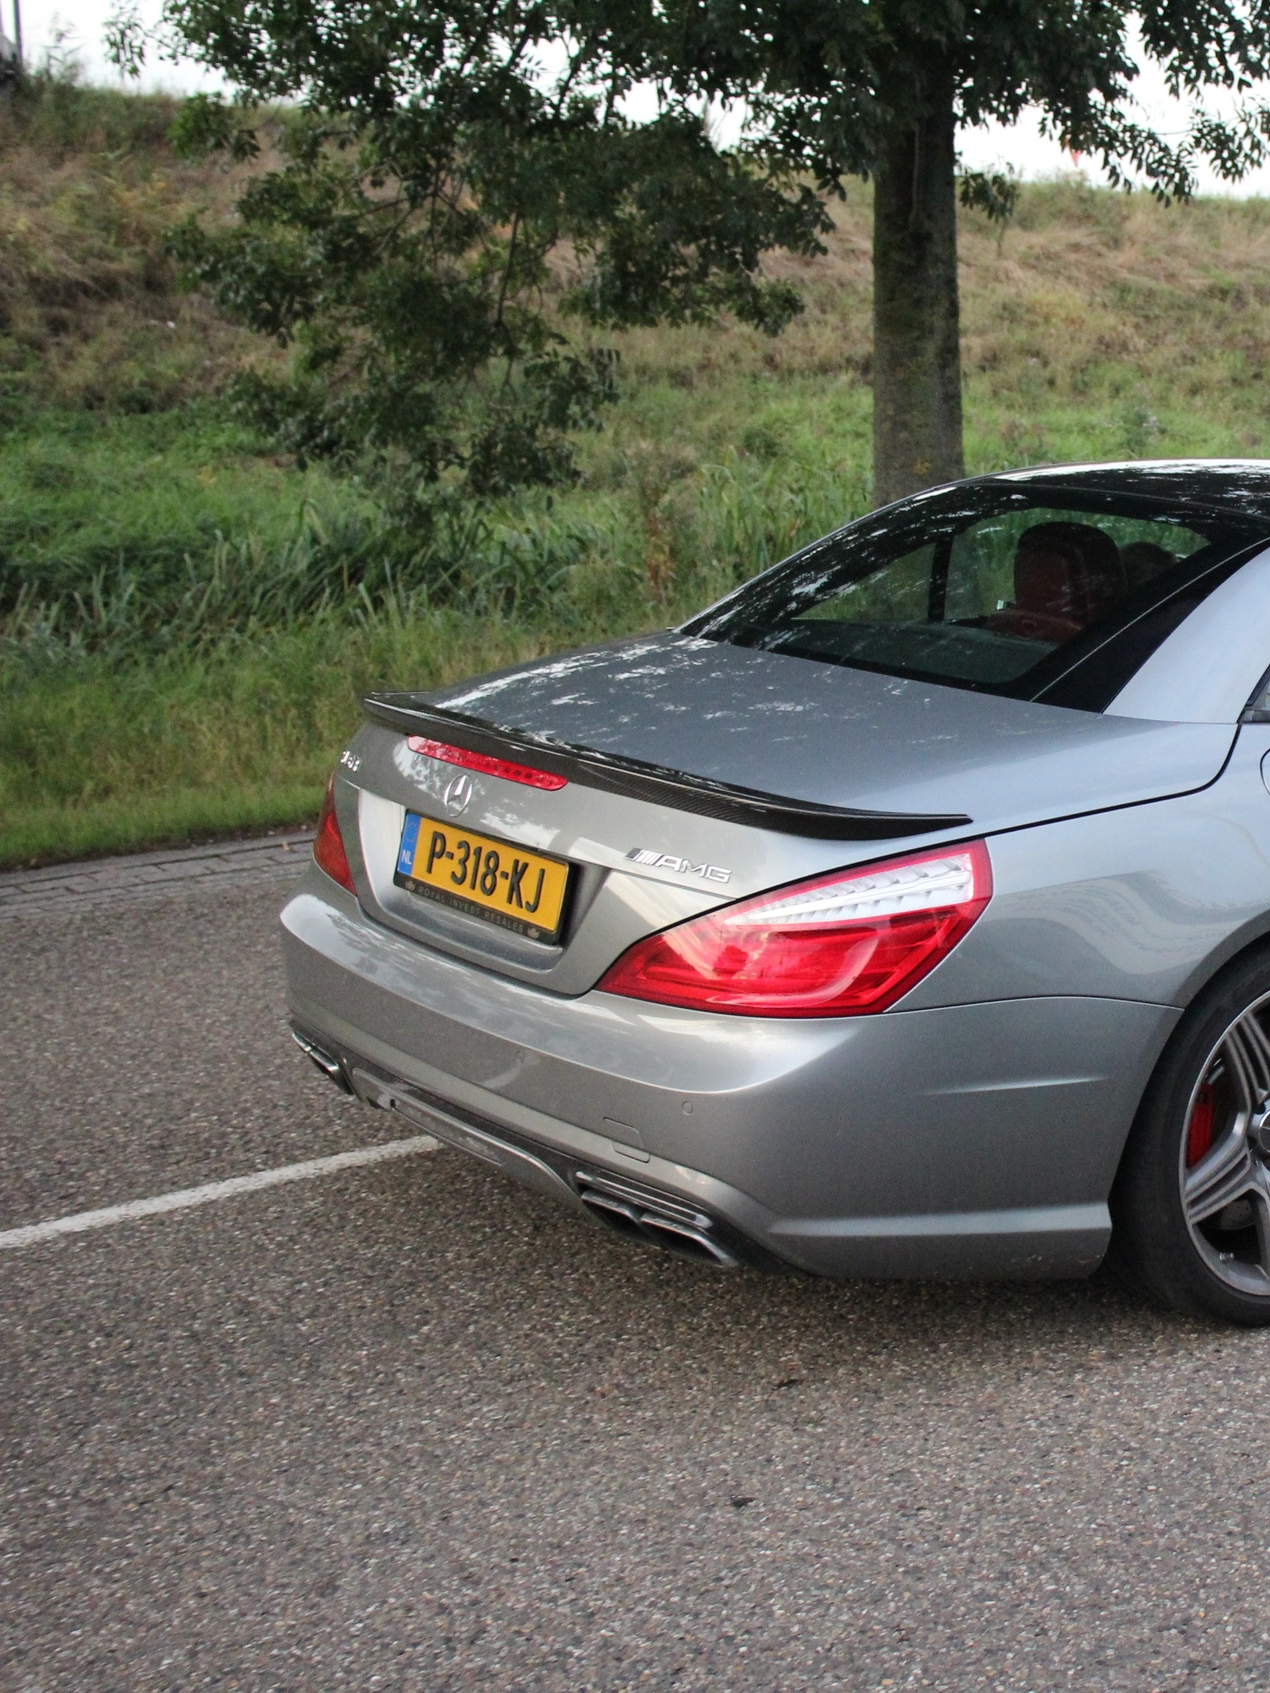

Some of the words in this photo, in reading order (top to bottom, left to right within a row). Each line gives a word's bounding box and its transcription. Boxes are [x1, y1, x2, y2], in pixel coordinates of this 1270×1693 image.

[400, 849, 412, 865] NL
[426, 831, 545, 913] P-318-KJ
[655, 854, 732, 884] AMG
[418, 885, 445, 903] ROYAL
[449, 896, 480, 915] INVEST
[484, 909, 524, 933] RESALES
